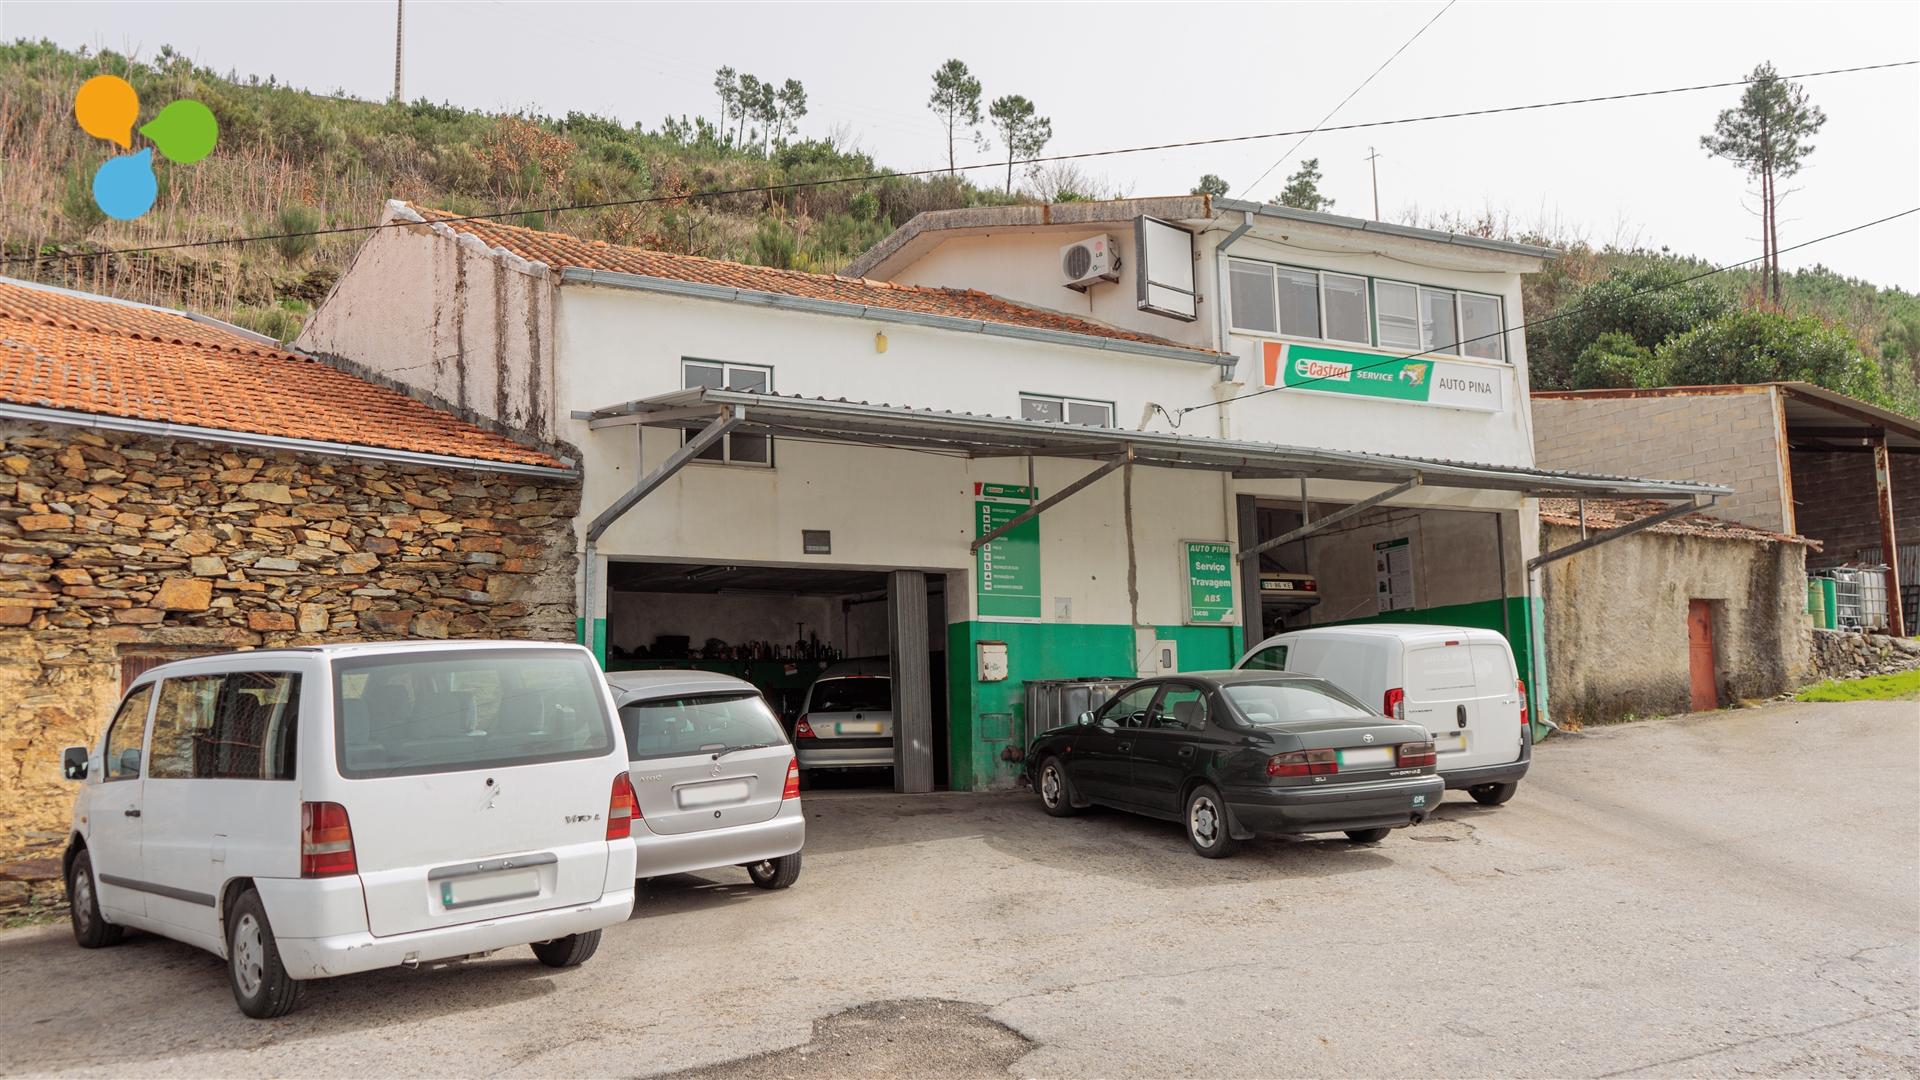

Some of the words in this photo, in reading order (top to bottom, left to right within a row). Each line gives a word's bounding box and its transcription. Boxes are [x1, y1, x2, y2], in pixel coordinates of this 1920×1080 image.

[1309, 361, 1349, 379] Castrol
[1356, 371, 1394, 382] SERVICE
[1439, 377, 1466, 392] AUTO
[1468, 380, 1492, 394] PINA
[1190, 544, 1210, 553] AUTO
[1211, 545, 1229, 553] PINA
[1195, 561, 1226, 573] Serviço
[1191, 577, 1231, 588] Travagem
[1204, 594, 1221, 602] ABS
